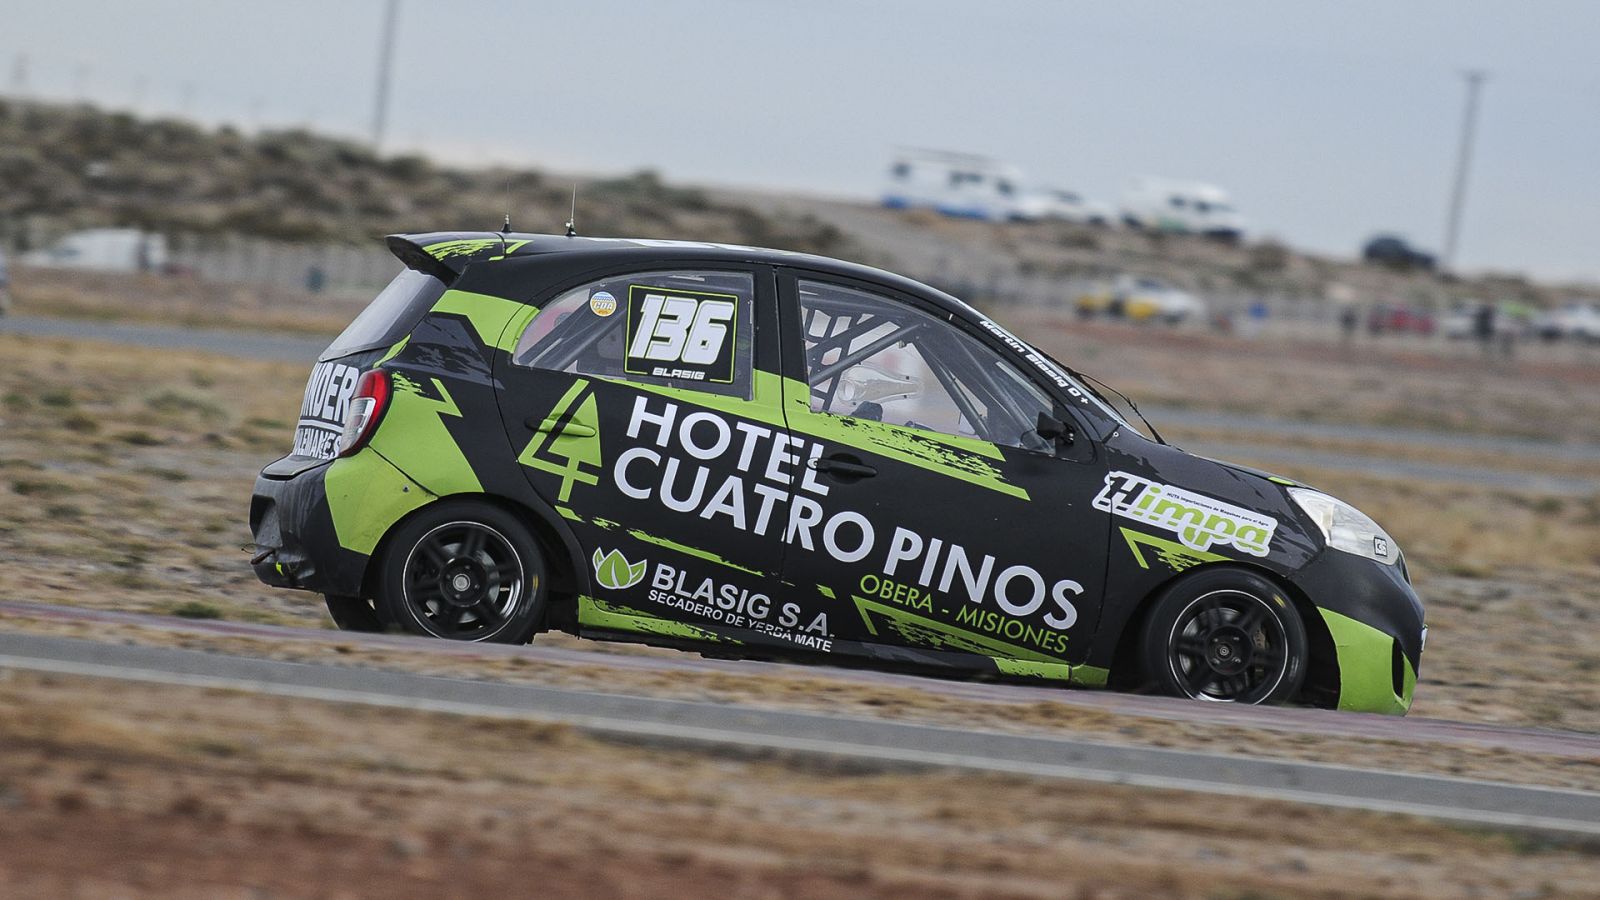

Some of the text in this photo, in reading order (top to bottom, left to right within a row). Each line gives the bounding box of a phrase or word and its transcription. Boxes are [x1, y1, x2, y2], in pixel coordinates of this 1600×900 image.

[628, 293, 735, 365] 136
[980, 320, 1026, 352] Martin
[1026, 354, 1069, 387] Blasig
[652, 367, 706, 380] BLASIG
[626, 396, 830, 497] HOTEL
[614, 447, 1085, 630] CUATRO PINOS
[1098, 476, 1268, 552] Himpa
[648, 589, 833, 653] SECADERO DE YERBA MATE
[651, 562, 771, 619] BLASIG
[860, 574, 933, 614] OBERA
[955, 604, 1070, 654] MISIONES
